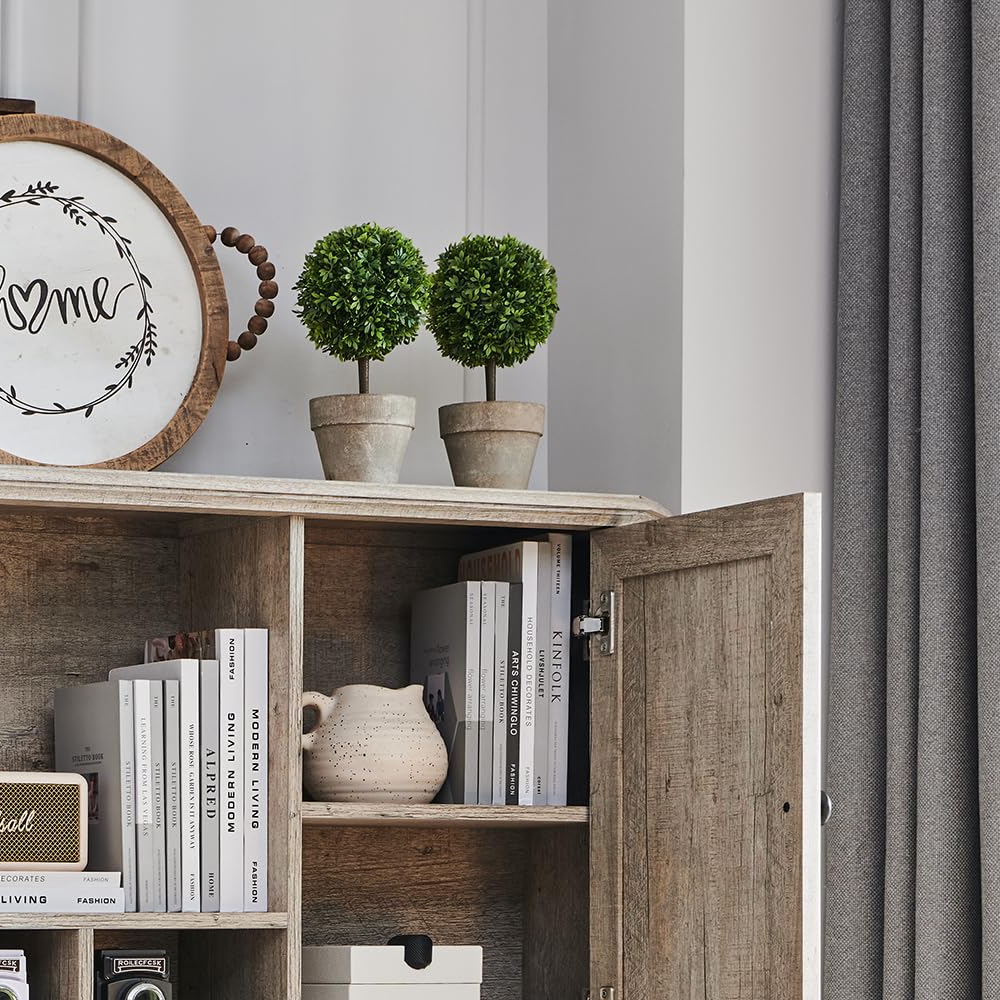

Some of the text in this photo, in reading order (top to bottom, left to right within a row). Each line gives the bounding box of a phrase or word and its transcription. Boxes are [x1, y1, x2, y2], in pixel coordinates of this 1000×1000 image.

[511, 650, 520, 677] ARTS
[526, 616, 534, 672] HOUSEHOLD
[550, 631, 563, 703] KINFOLK
[537, 649, 545, 698] LIVSHJULET
[510, 679, 519, 736] CHIWINGLO
[525, 674, 533, 727] DECORATES
[140, 717, 148, 761] LEARNING
[227, 712, 236, 762] LIVING
[251, 709, 260, 772] MODERN
[206, 748, 216, 819] ALPRED
[227, 770, 236, 833] MODERN
[251, 780, 259, 829] LIVING
[1, 895, 47, 904] LIVING
[77, 897, 116, 905] FASHION
